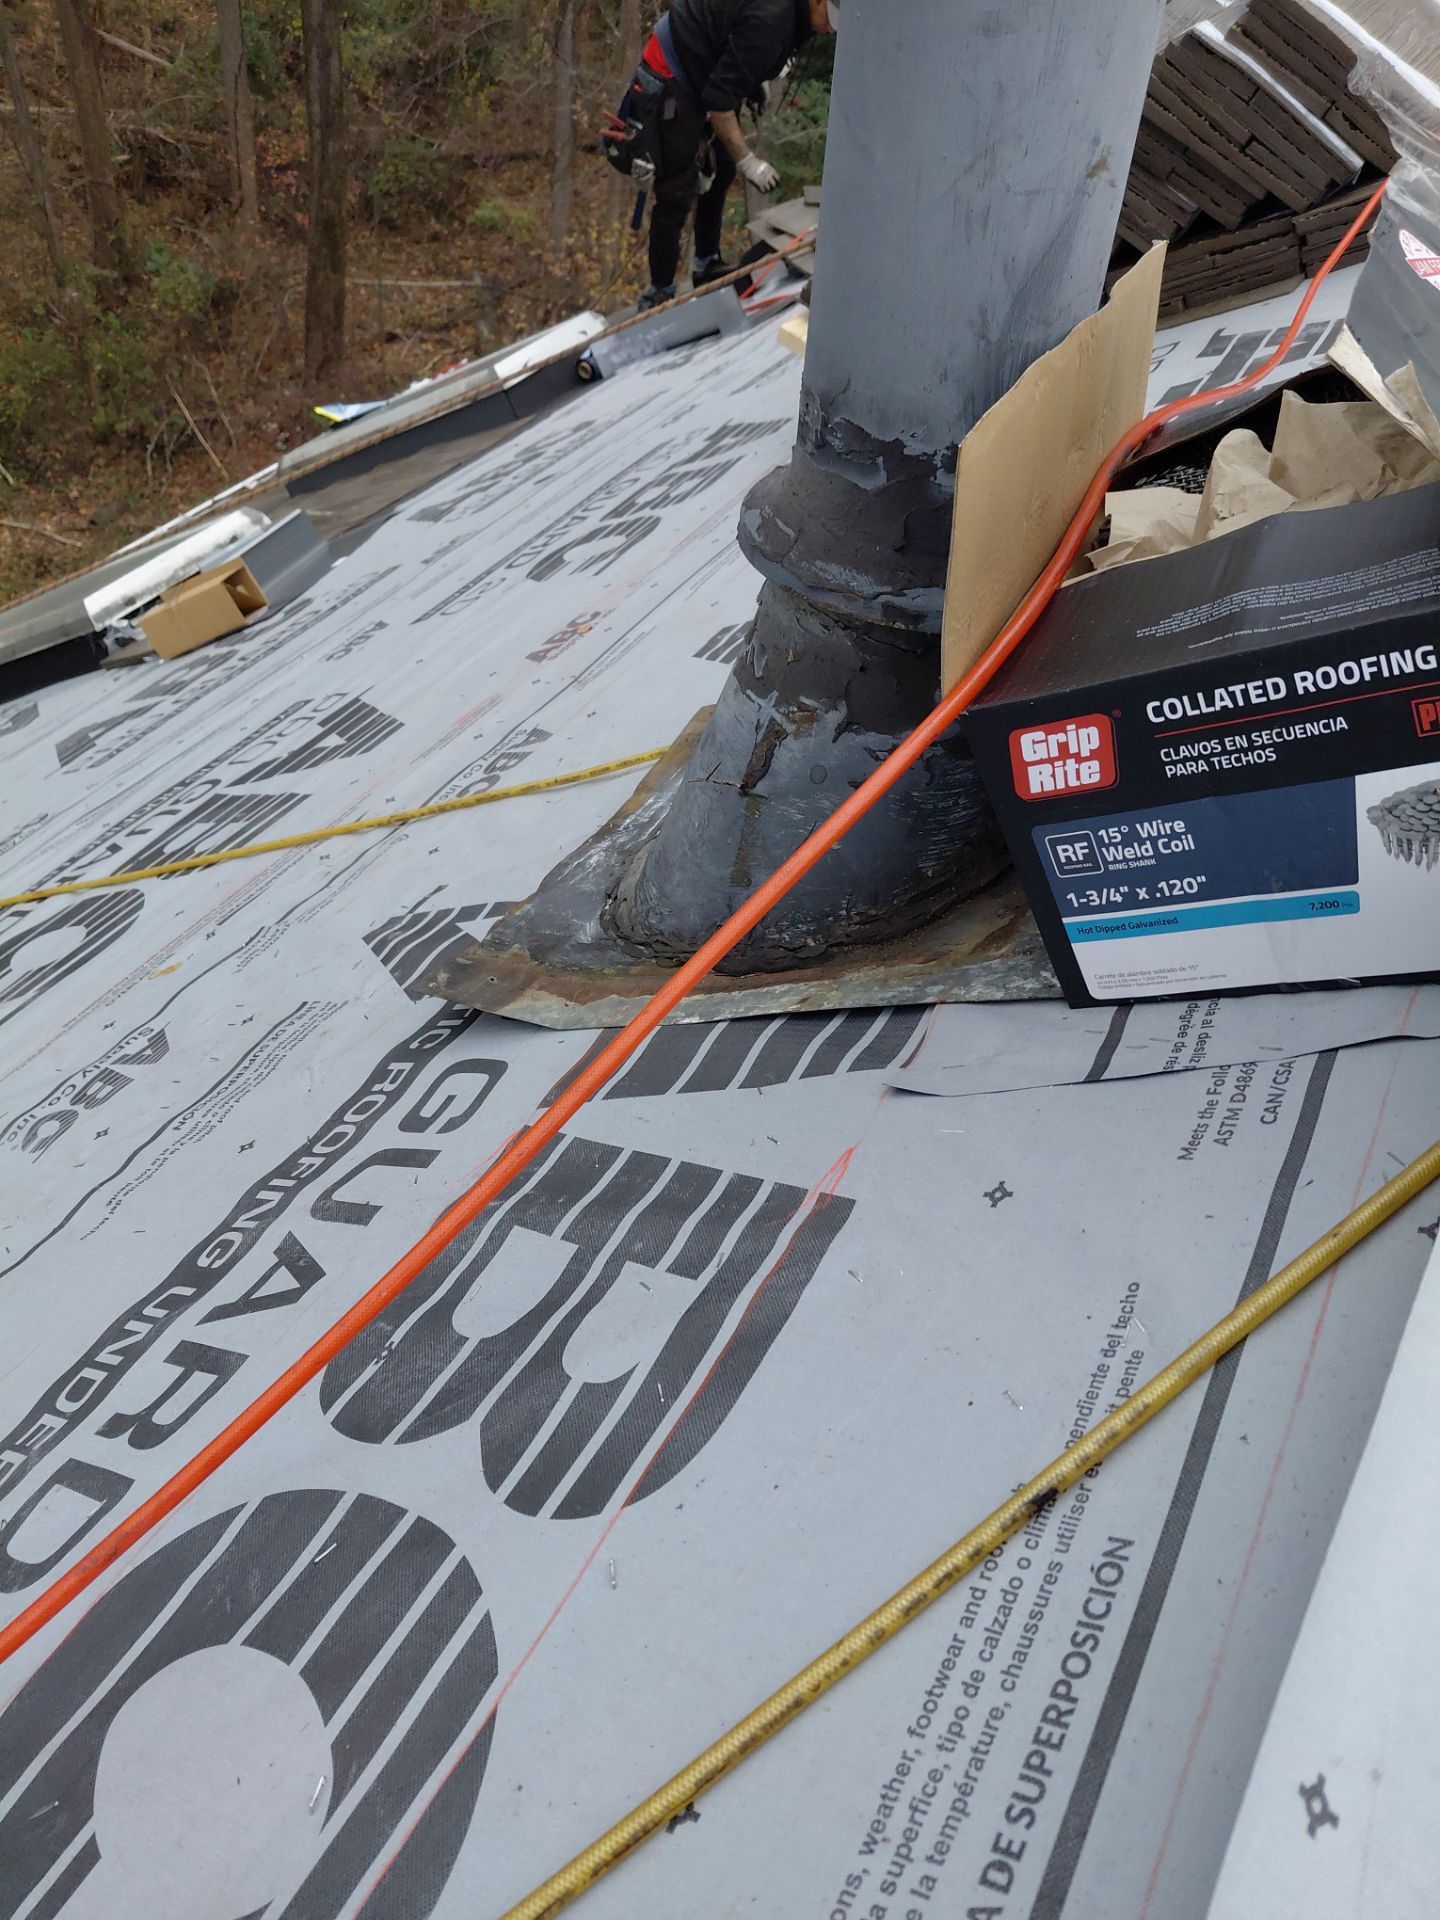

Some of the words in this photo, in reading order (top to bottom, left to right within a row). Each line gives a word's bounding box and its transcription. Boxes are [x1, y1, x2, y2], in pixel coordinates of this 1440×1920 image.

[1146, 676, 1287, 723] COLLATED
[1293, 644, 1438, 695] ROOFING
[1020, 724, 1100, 762] Grip
[1159, 739, 1222, 762] CLAVOS
[1224, 734, 1249, 750] EN
[1250, 716, 1349, 747] SECUENCIA
[1027, 758, 1101, 794] Rite
[1164, 759, 1210, 779] PARA
[1210, 748, 1277, 771] TECHOS
[1097, 825, 1129, 845] 15°
[1135, 819, 1186, 839] Wire
[1101, 843, 1154, 862] Weld
[1158, 834, 1195, 854] Coil
[1056, 842, 1090, 863] RF
[1108, 862, 1128, 871] RING
[1129, 858, 1156, 868] SHANK
[1066, 885, 1129, 908] 1-3/4"
[1136, 886, 1150, 900] x
[1155, 875, 1207, 898] .120"
[1308, 900, 1340, 911] 7,200
[1077, 926, 1094, 935] Hot
[1095, 922, 1127, 935] Dipped
[1128, 916, 1178, 930] Galvanized
[1201, 1018, 1215, 1029] al
[82, 1026, 155, 1079] Supply
[1171, 1041, 1188, 1054] de
[22, 1020, 172, 1164] ABC
[40, 1083, 77, 1109] Co.
[1260, 1059, 1297, 1125] CAN/CSA
[1177, 1123, 1209, 1161] Meets
[1198, 1099, 1219, 1120] the
[1213, 1107, 1244, 1147] ASTM
[195, 1062, 416, 1271] ROOFING
[1111, 1281, 1141, 1330] techo
[0, 1058, 509, 1594] GUARD
[1103, 1332, 1126, 1359] del
[1064, 1362, 1111, 1451] pendiente
[1017, 1556, 1032, 1571] o
[909, 1874, 938, 1900] la
[925, 1701, 1012, 1866] température,
[1000, 1559, 1063, 1693] chaussures
[1055, 1482, 1093, 1554] utiliser
[1116, 1349, 1145, 1399] pente
[978, 1576, 1024, 1663] calzado
[961, 1669, 986, 1699] de
[858, 1749, 922, 1857] weather,
[907, 1633, 967, 1740] footwear
[959, 1586, 987, 1629] and
[936, 1705, 970, 1754] tipo
[978, 1832, 1027, 1896] DE
[1004, 1536, 1136, 1831] SUPERPOSICIÓN
